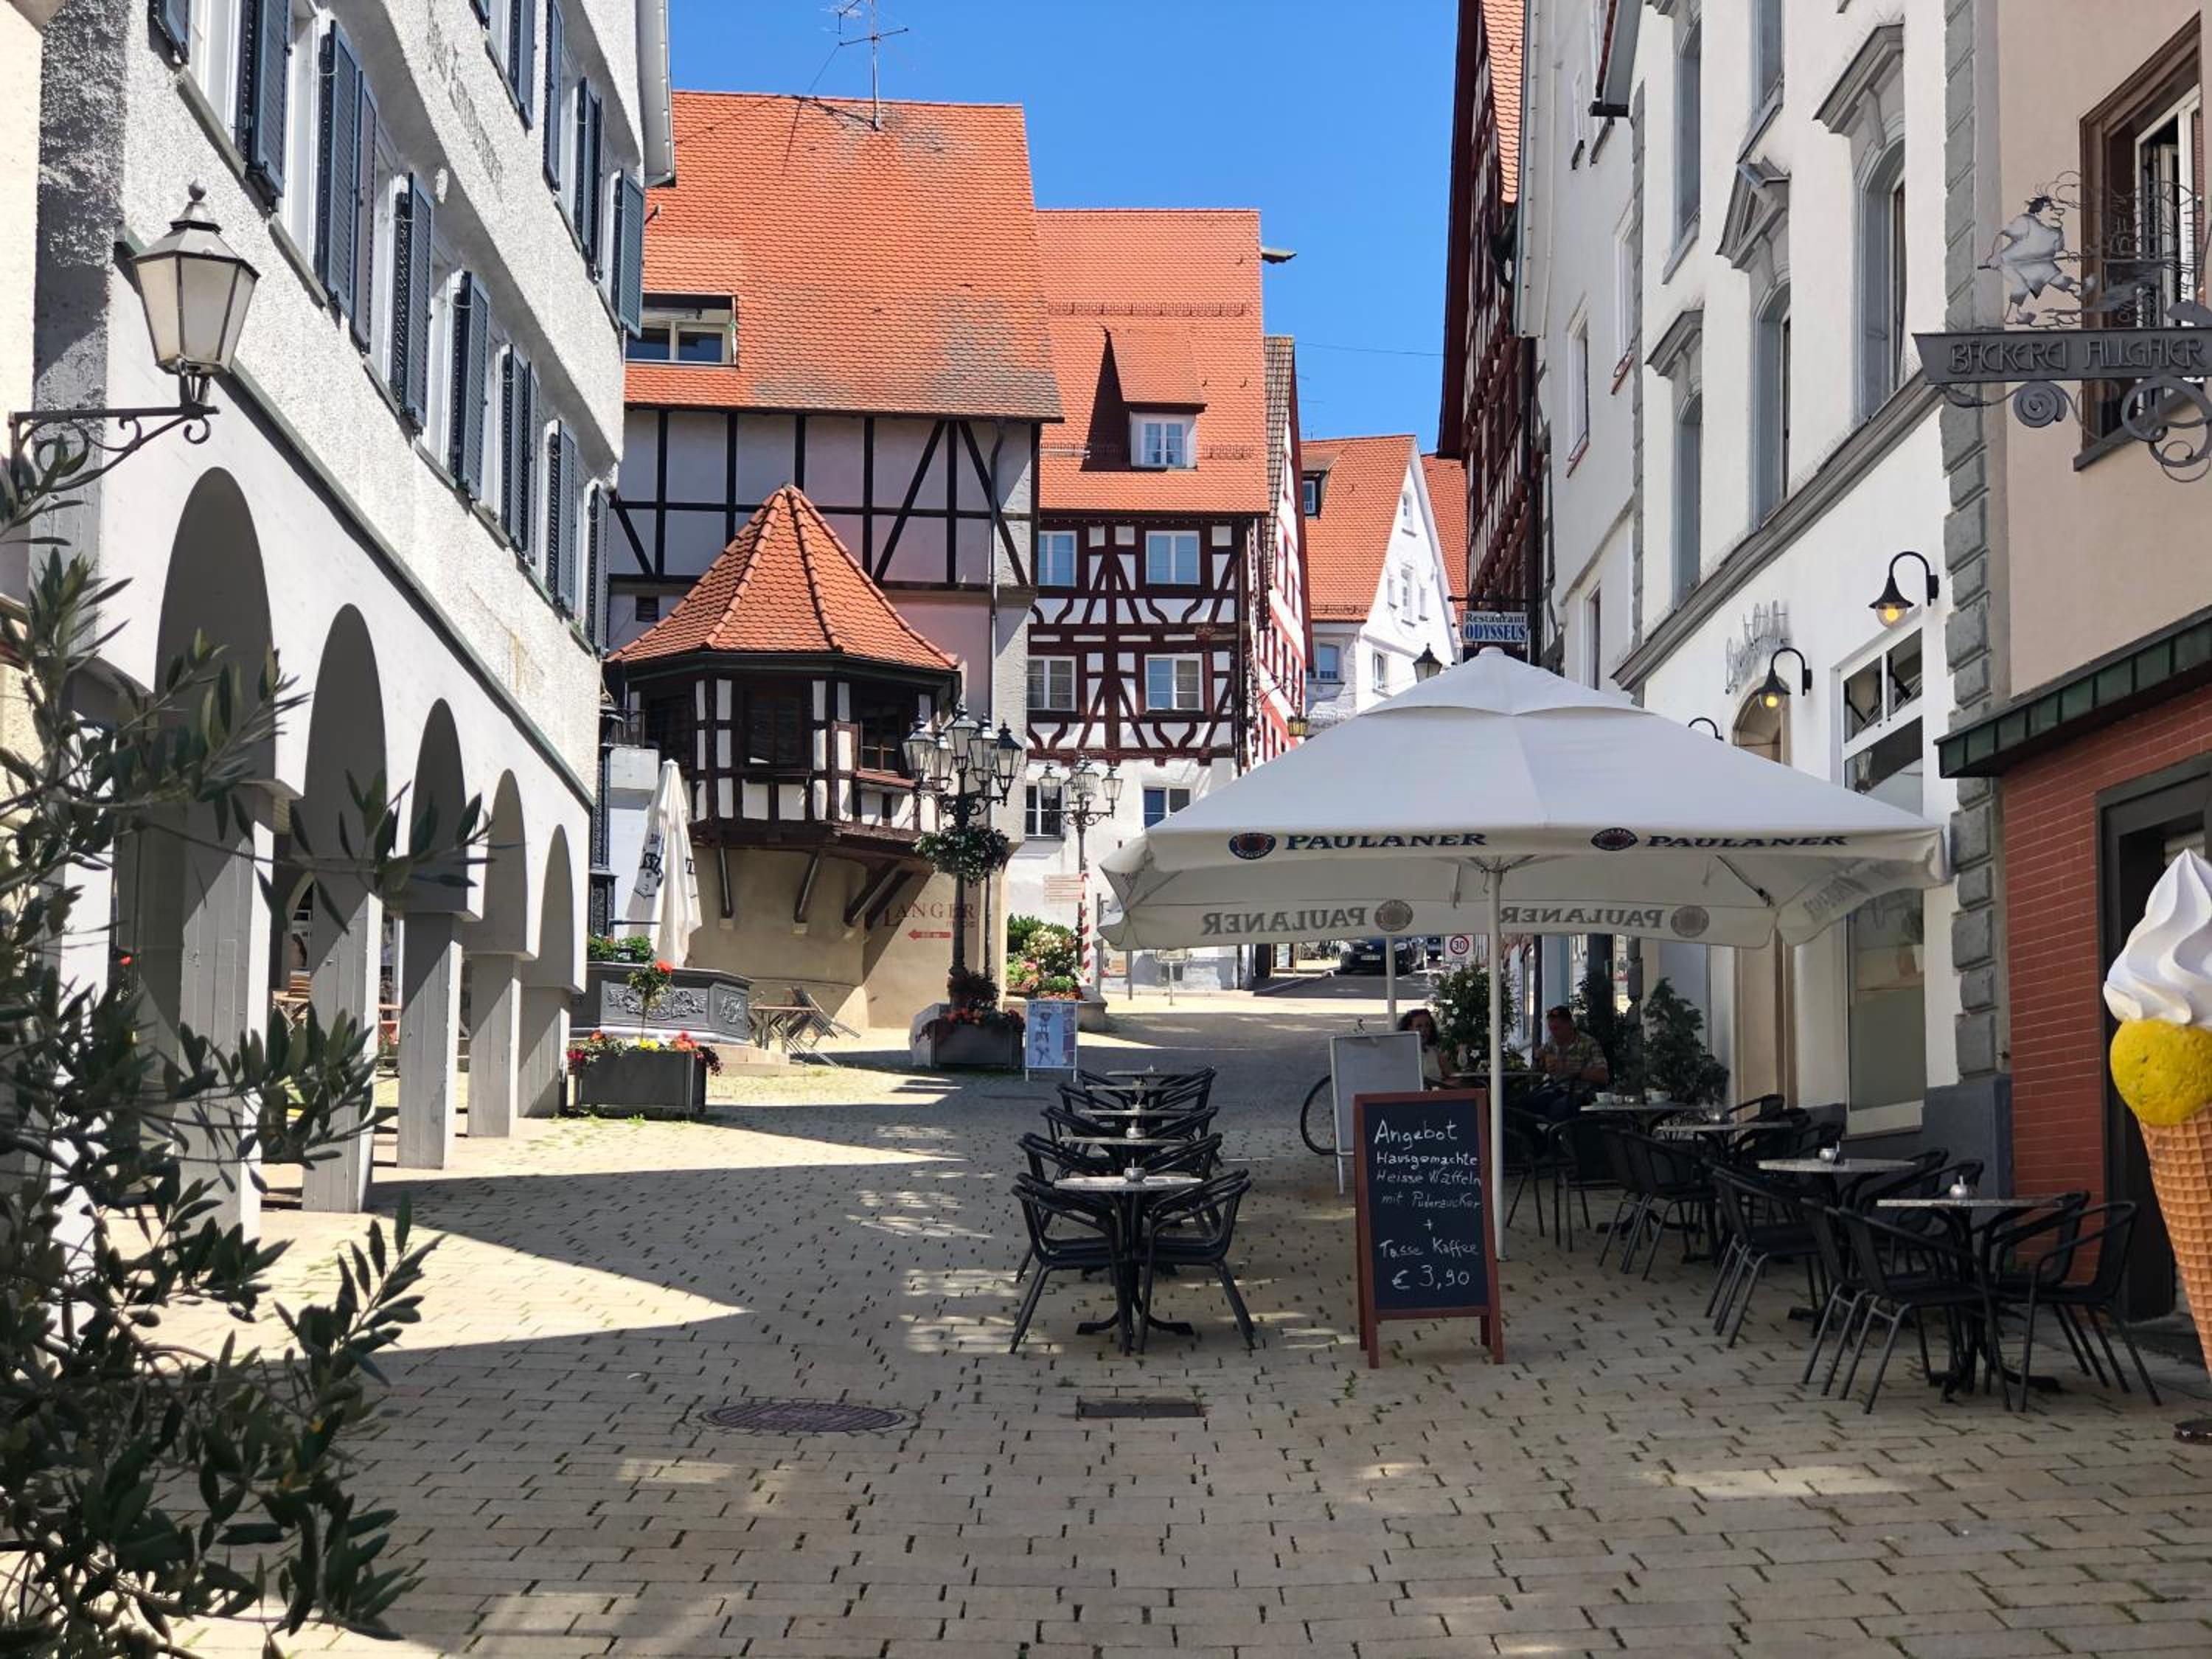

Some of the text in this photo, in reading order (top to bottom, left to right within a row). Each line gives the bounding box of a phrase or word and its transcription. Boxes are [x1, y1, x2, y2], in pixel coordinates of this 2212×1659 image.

[1947, 338, 2067, 375] BÄCKEREI
[1465, 625, 1526, 640] ODYSSEUS
[1286, 833, 1486, 850] PAULANER
[1645, 835, 1848, 848] PAULANER
[1453, 940, 1465, 950] 30
[1374, 1119, 1458, 1150] Angebot
[1428, 1166, 1481, 1186] Waffeln
[1392, 1264, 1470, 1290] € 3,90
